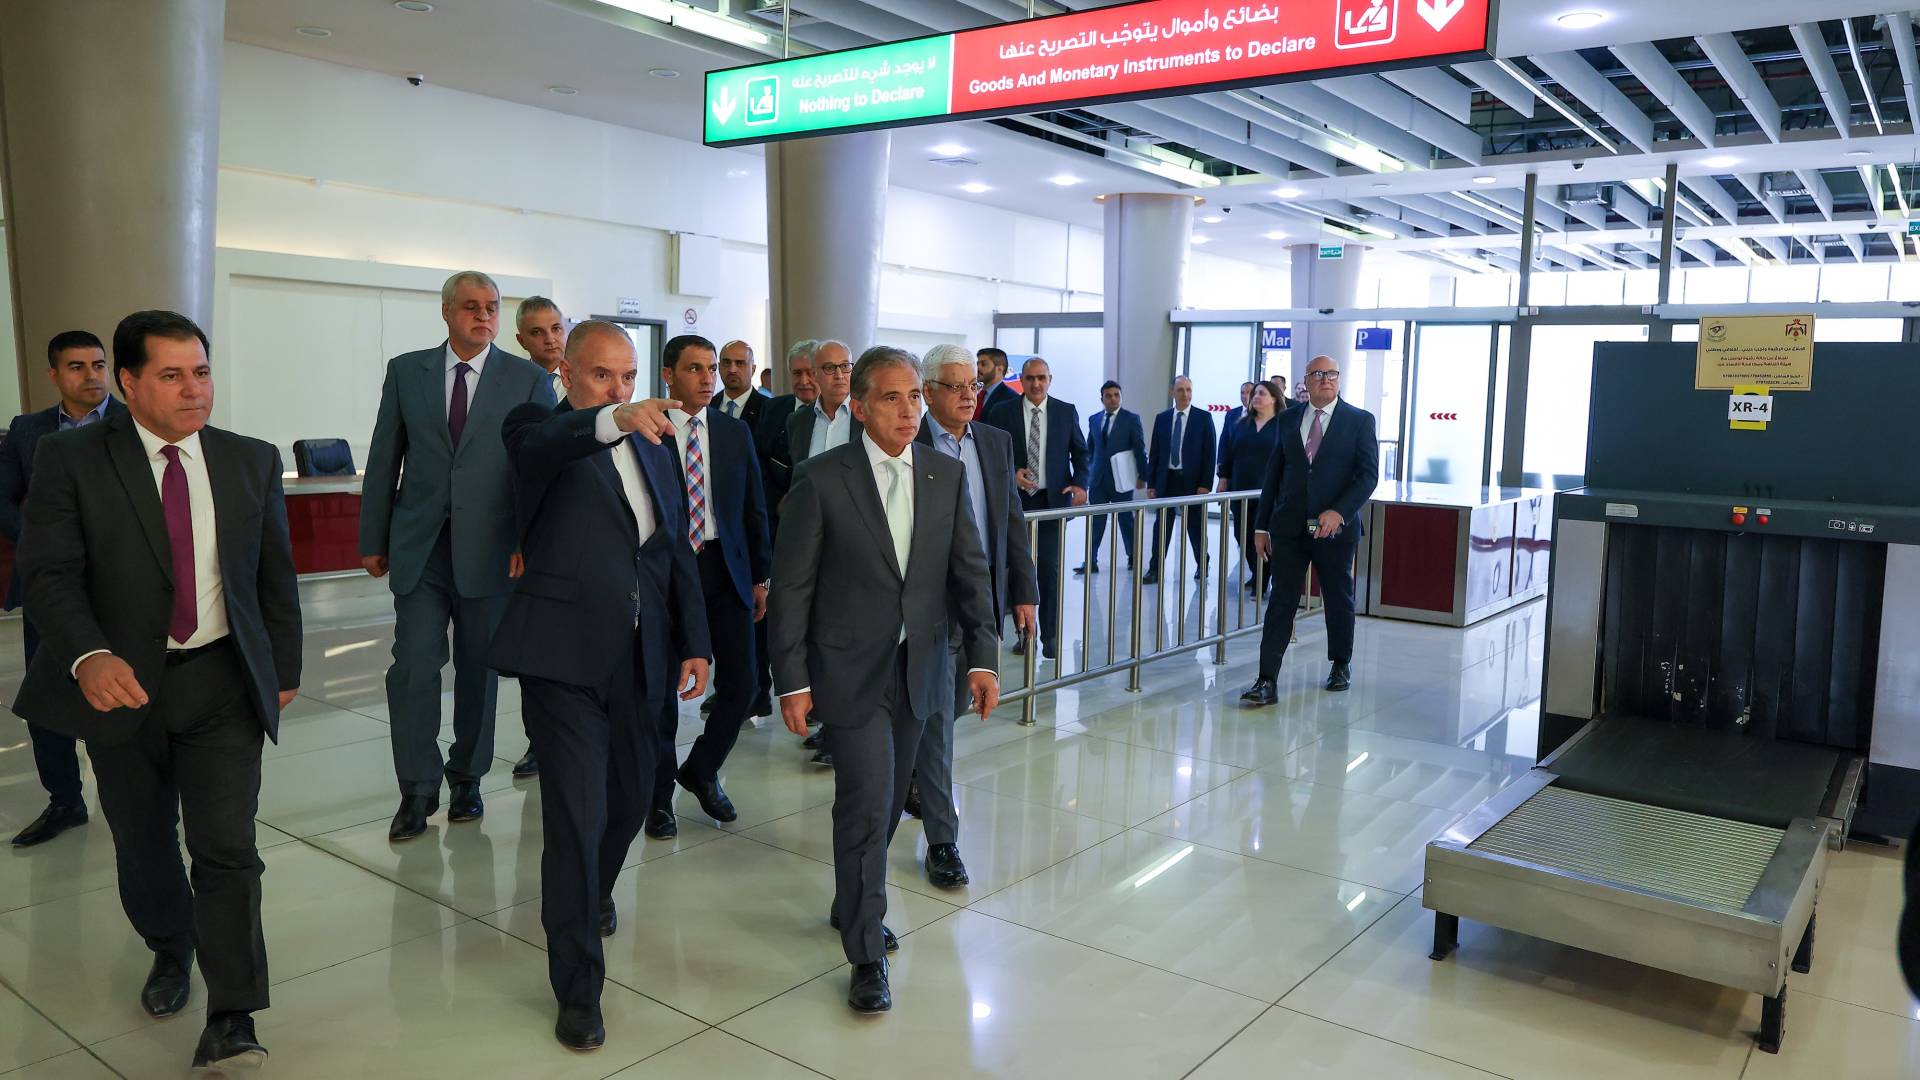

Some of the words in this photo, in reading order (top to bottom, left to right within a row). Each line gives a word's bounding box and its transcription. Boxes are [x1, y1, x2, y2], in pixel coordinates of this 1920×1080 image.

[1162, 8, 1219, 38] وأموال
[1223, 3, 1279, 30] بضائع
[999, 41, 1035, 60] عنها
[1037, 30, 1097, 57] التصريح
[894, 60, 926, 76] يوجد
[927, 56, 936, 70] لا
[969, 76, 1014, 94] Goods
[1017, 71, 1046, 88] And
[1050, 63, 1119, 84] Monetary
[1123, 49, 1220, 74] Instruments
[1225, 45, 1243, 61] to
[1247, 36, 1316, 58] Declare
[791, 75, 813, 89] عنه
[814, 67, 859, 89] للتصريح
[799, 94, 850, 113] Nothing
[853, 92, 868, 107] to
[871, 85, 925, 105] Declare
[1732, 401, 1769, 413] XR-4
